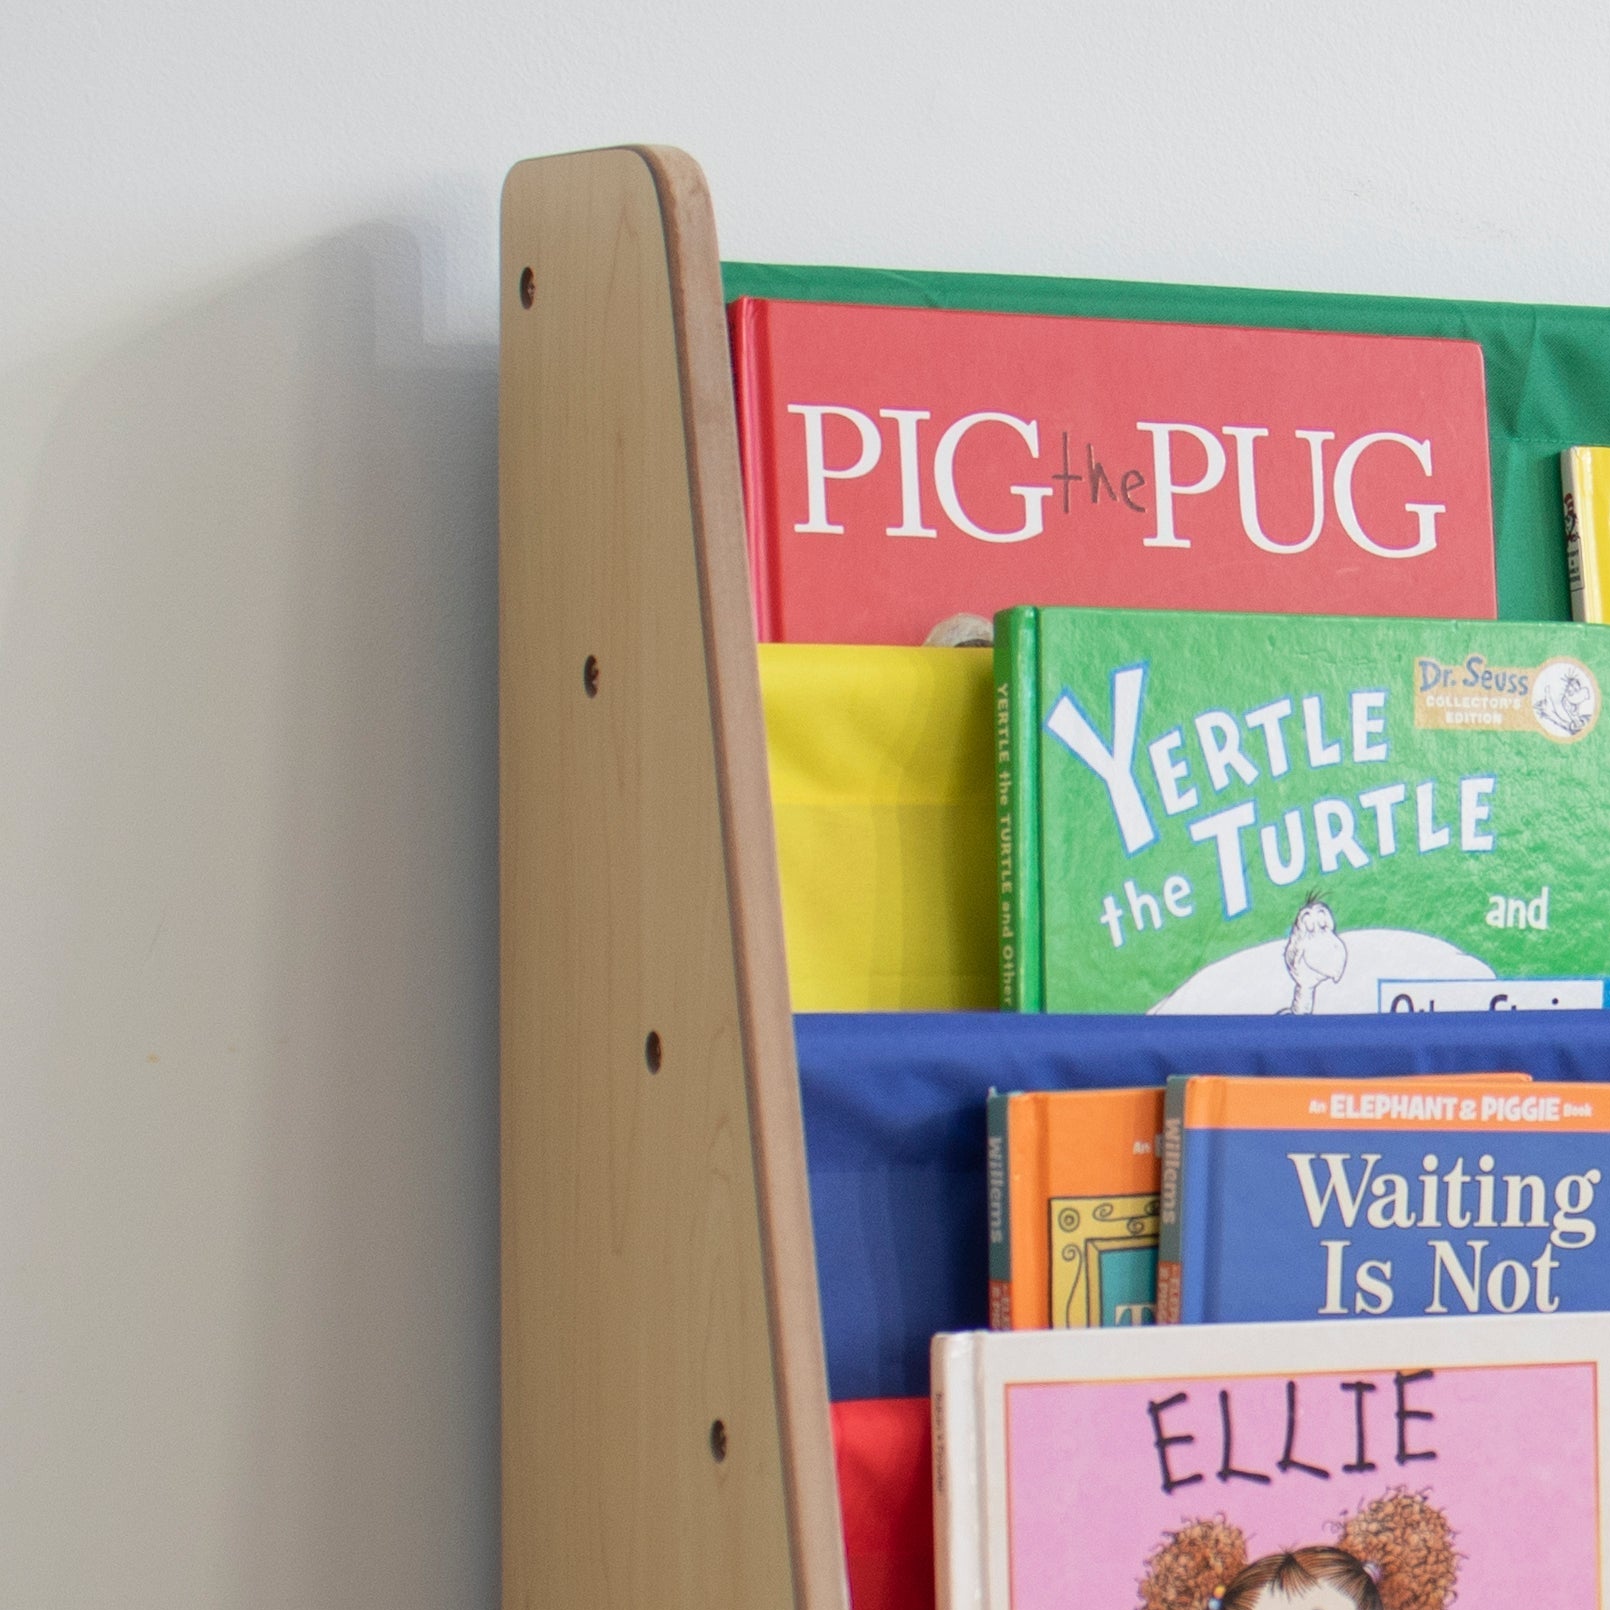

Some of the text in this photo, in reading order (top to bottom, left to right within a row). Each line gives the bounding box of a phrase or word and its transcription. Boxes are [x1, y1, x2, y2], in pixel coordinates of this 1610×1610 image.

[787, 402, 1447, 559] PIG the PUG
[1418, 656, 1529, 696] Dr. Seuss
[1426, 695, 1522, 710] COLLECTOR'S
[997, 682, 1011, 764] YERTLE
[1043, 660, 1389, 858] YERTLE
[1446, 711, 1503, 725] EDITION
[999, 769, 1012, 806] the
[999, 813, 1014, 895] TURTLE
[1100, 774, 1549, 948] the TURTLE and
[1001, 901, 1014, 939] and
[1132, 1140, 1151, 1156] An
[1308, 1093, 1593, 1122] An ELEPHANT & PIGGIE Book
[989, 1136, 1003, 1244] Willems
[1163, 1117, 1181, 1226] Willems
[1288, 1152, 1601, 1250] Waiting
[1318, 1239, 1561, 1316] Is Not
[1147, 1367, 1439, 1497] ELLIE
